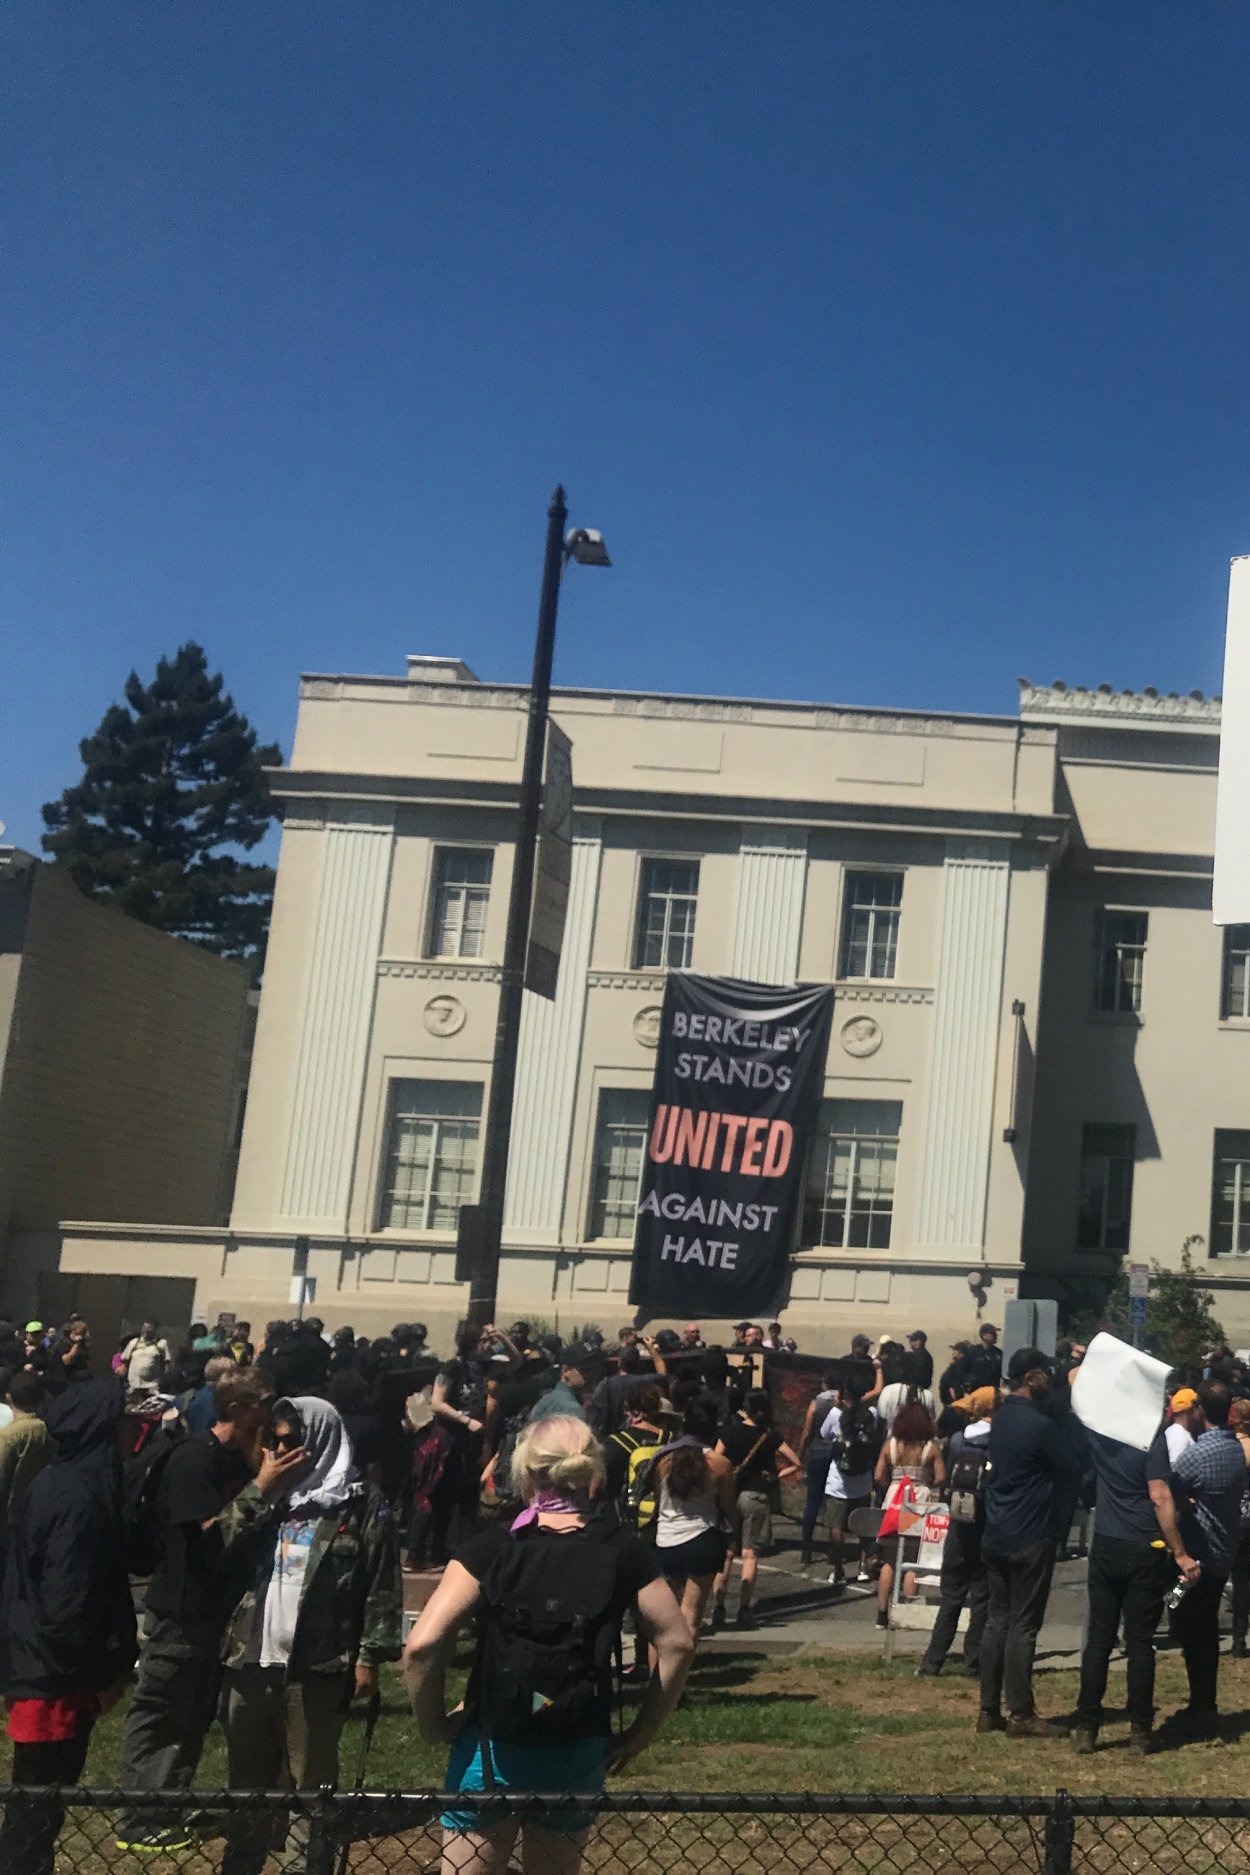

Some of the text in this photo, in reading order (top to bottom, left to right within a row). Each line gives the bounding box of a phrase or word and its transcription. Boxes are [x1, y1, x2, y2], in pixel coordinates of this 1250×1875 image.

[672, 1012, 811, 1052] BERKELEY
[674, 1053, 792, 1092] STANDS
[650, 1104, 794, 1178] UNITED
[637, 1189, 778, 1232] AGAINST
[660, 1234, 739, 1270] HATE
